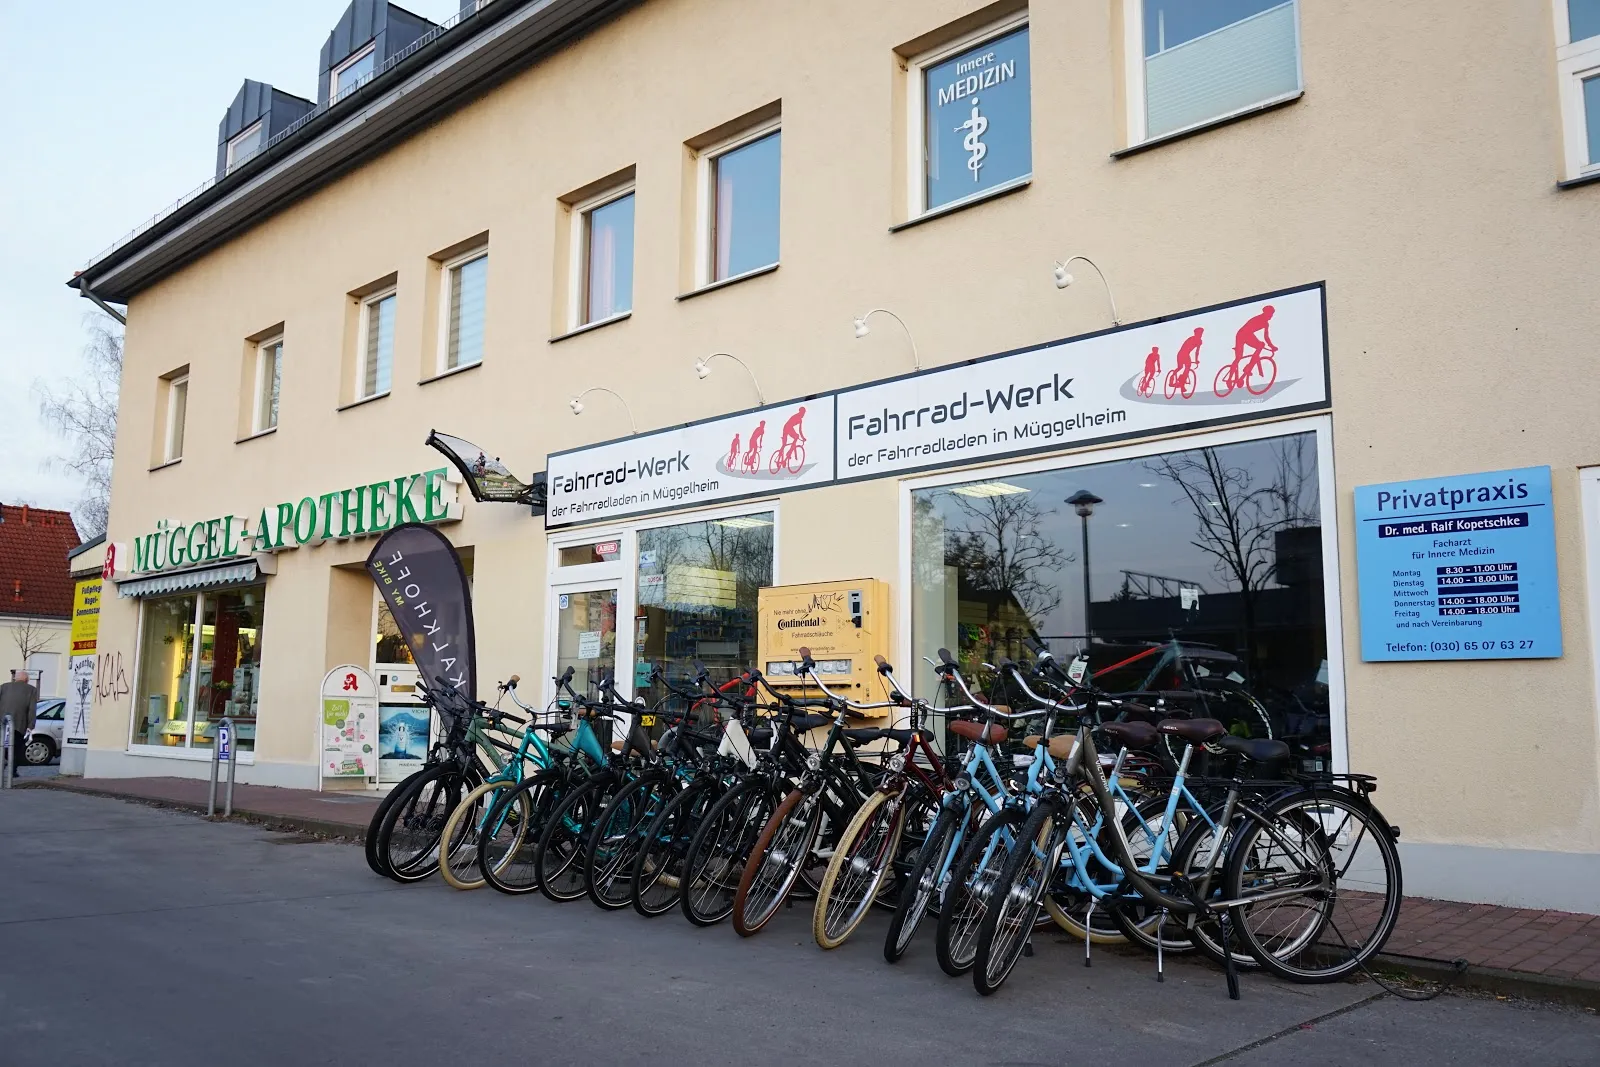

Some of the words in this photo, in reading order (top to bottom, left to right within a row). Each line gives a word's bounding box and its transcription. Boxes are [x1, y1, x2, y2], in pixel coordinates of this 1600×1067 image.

[957, 52, 994, 75] Innere
[938, 59, 1014, 106] MEDIZIN
[848, 373, 1075, 440] Fahrrad-Werk
[848, 449, 873, 468] der
[877, 431, 988, 463] Fahrradladen
[992, 427, 1009, 442] in
[1013, 407, 1127, 442] Müggelheim
[552, 450, 690, 496] Fahrrad-Werk
[551, 504, 567, 517] der
[570, 493, 638, 515] Fahrradladen
[640, 490, 650, 502] in
[652, 479, 719, 501] Müggelheim
[1377, 478, 1528, 512] Privatpraxis
[131, 467, 449, 574] MÜGGEL-APOTHEKE
[1385, 526, 1399, 536] Dr.
[1403, 524, 1428, 535] med.
[1431, 521, 1454, 532] Ralf
[1456, 517, 1520, 531] Kopetschke
[598, 544, 615, 552] ABUS
[1433, 538, 1472, 548] Facharzt
[1412, 551, 1425, 560] für
[1428, 549, 1456, 558] Innere
[1459, 547, 1495, 556] Medizin
[1392, 570, 1421, 578] Montag
[1445, 566, 1464, 574] 8.30
[1498, 563, 1513, 571] Uhr
[1393, 579, 1424, 588] Dienstag
[1441, 577, 1464, 585] 14.00
[1474, 575, 1497, 583] 18.00
[1499, 573, 1514, 582] Uhr
[82, 585, 102, 595] Fußpfleg
[1393, 589, 1429, 597] Mittwoch
[1394, 599, 1435, 608] Donnerstag
[1475, 596, 1497, 604] 18.00
[1500, 595, 1515, 603] Uhr
[1394, 609, 1420, 619] Freitag
[1443, 608, 1466, 616] 14.00
[1475, 606, 1498, 614] 18.00
[1500, 605, 1515, 613] Uhr
[777, 617, 820, 631] Continental
[1396, 621, 1410, 629] und
[1412, 620, 1430, 628] nach
[1432, 619, 1483, 628] Vereinbarung
[1386, 642, 1427, 652] Telefon:
[1430, 641, 1460, 652] (030)
[1464, 641, 1478, 651] 65
[1482, 641, 1496, 650] 07
[1500, 640, 1515, 650] 63
[1519, 640, 1534, 650] 27
[219, 728, 229, 752] P
[1095, 760, 1110, 793] VICTORIA
